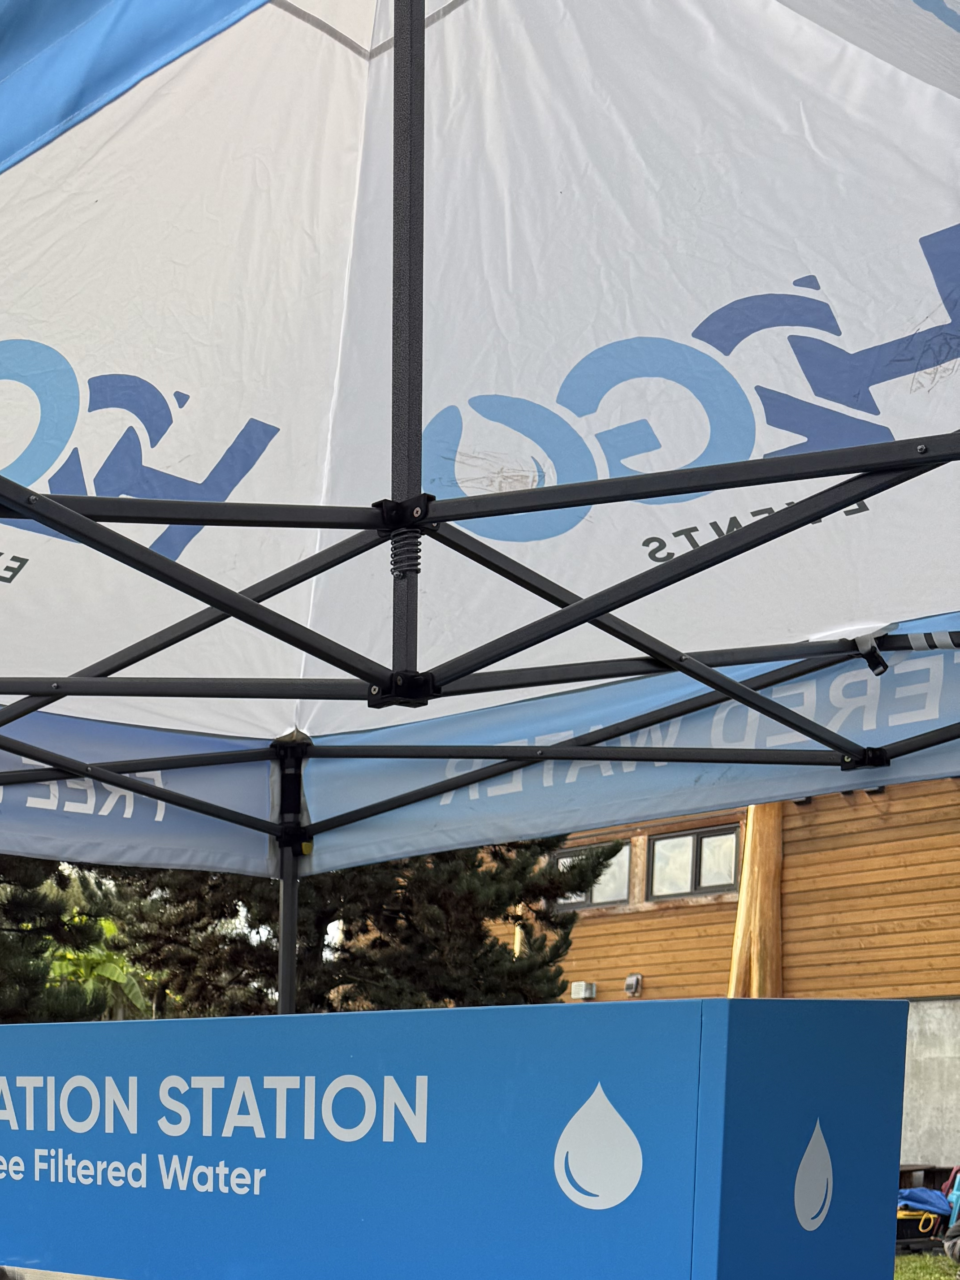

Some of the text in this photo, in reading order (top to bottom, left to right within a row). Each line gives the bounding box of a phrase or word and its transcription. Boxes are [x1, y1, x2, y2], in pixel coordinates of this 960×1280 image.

[157, 1074, 429, 1144] STATION
[34, 1148, 147, 1189] Filtered
[157, 1154, 267, 1196] Water
